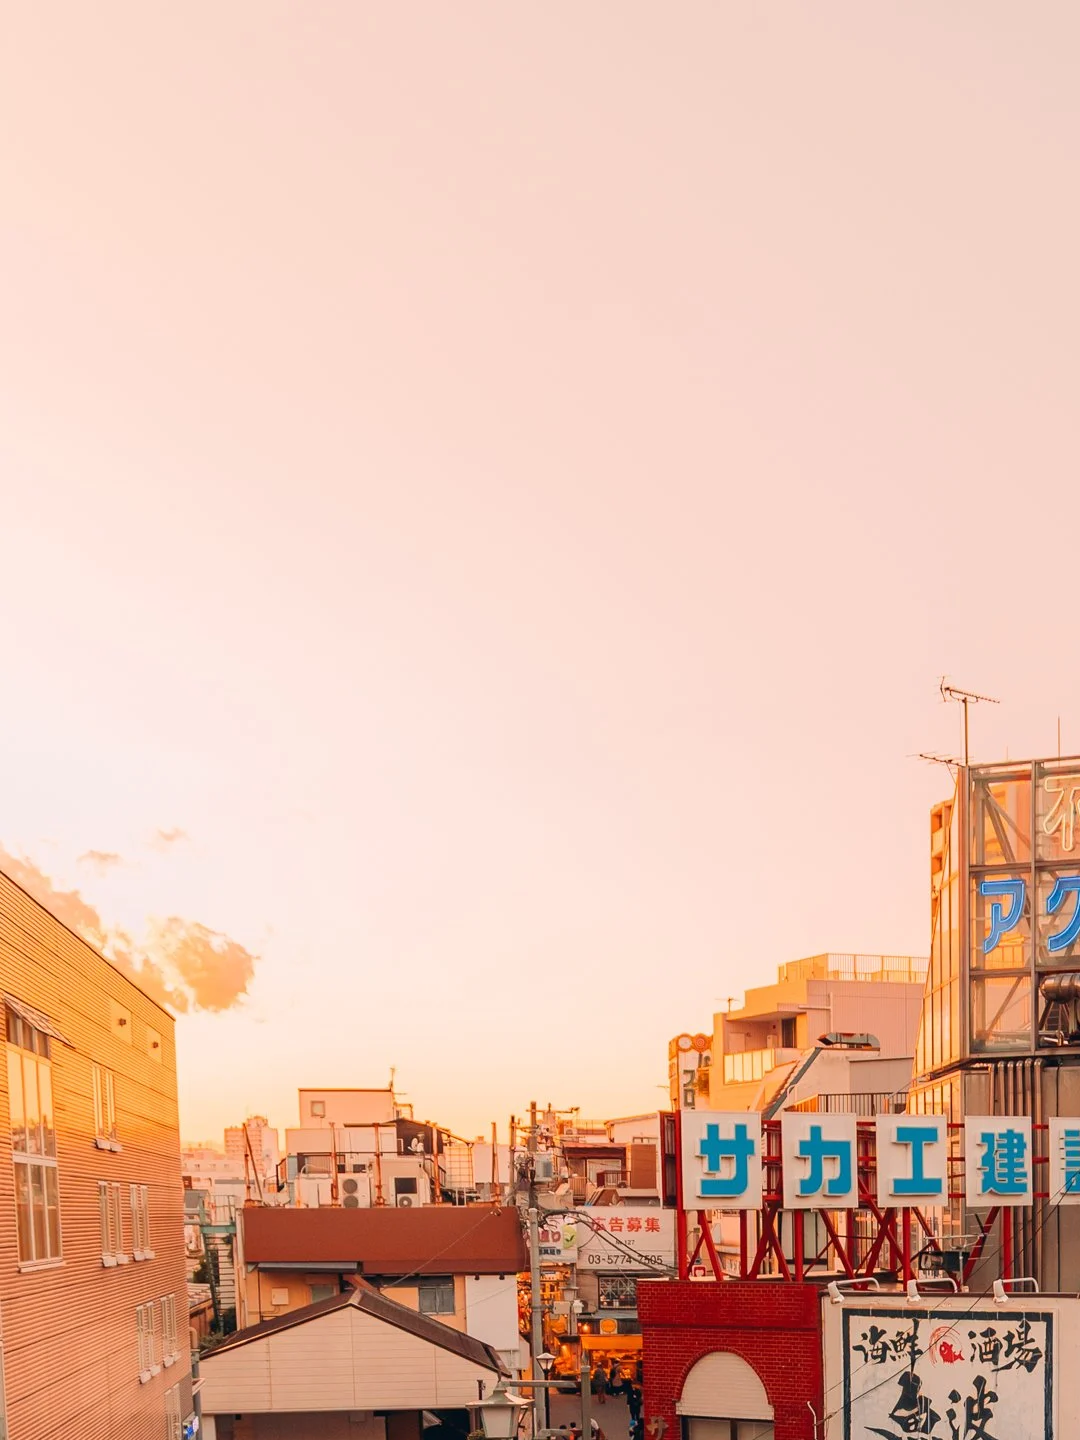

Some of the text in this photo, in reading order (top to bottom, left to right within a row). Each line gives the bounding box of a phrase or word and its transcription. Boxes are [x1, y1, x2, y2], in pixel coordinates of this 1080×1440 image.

[591, 1217, 661, 1233] 広告募集
[588, 1254, 663, 1265] 03-57747505
[853, 1318, 1043, 1377] 海鮮 酒場
